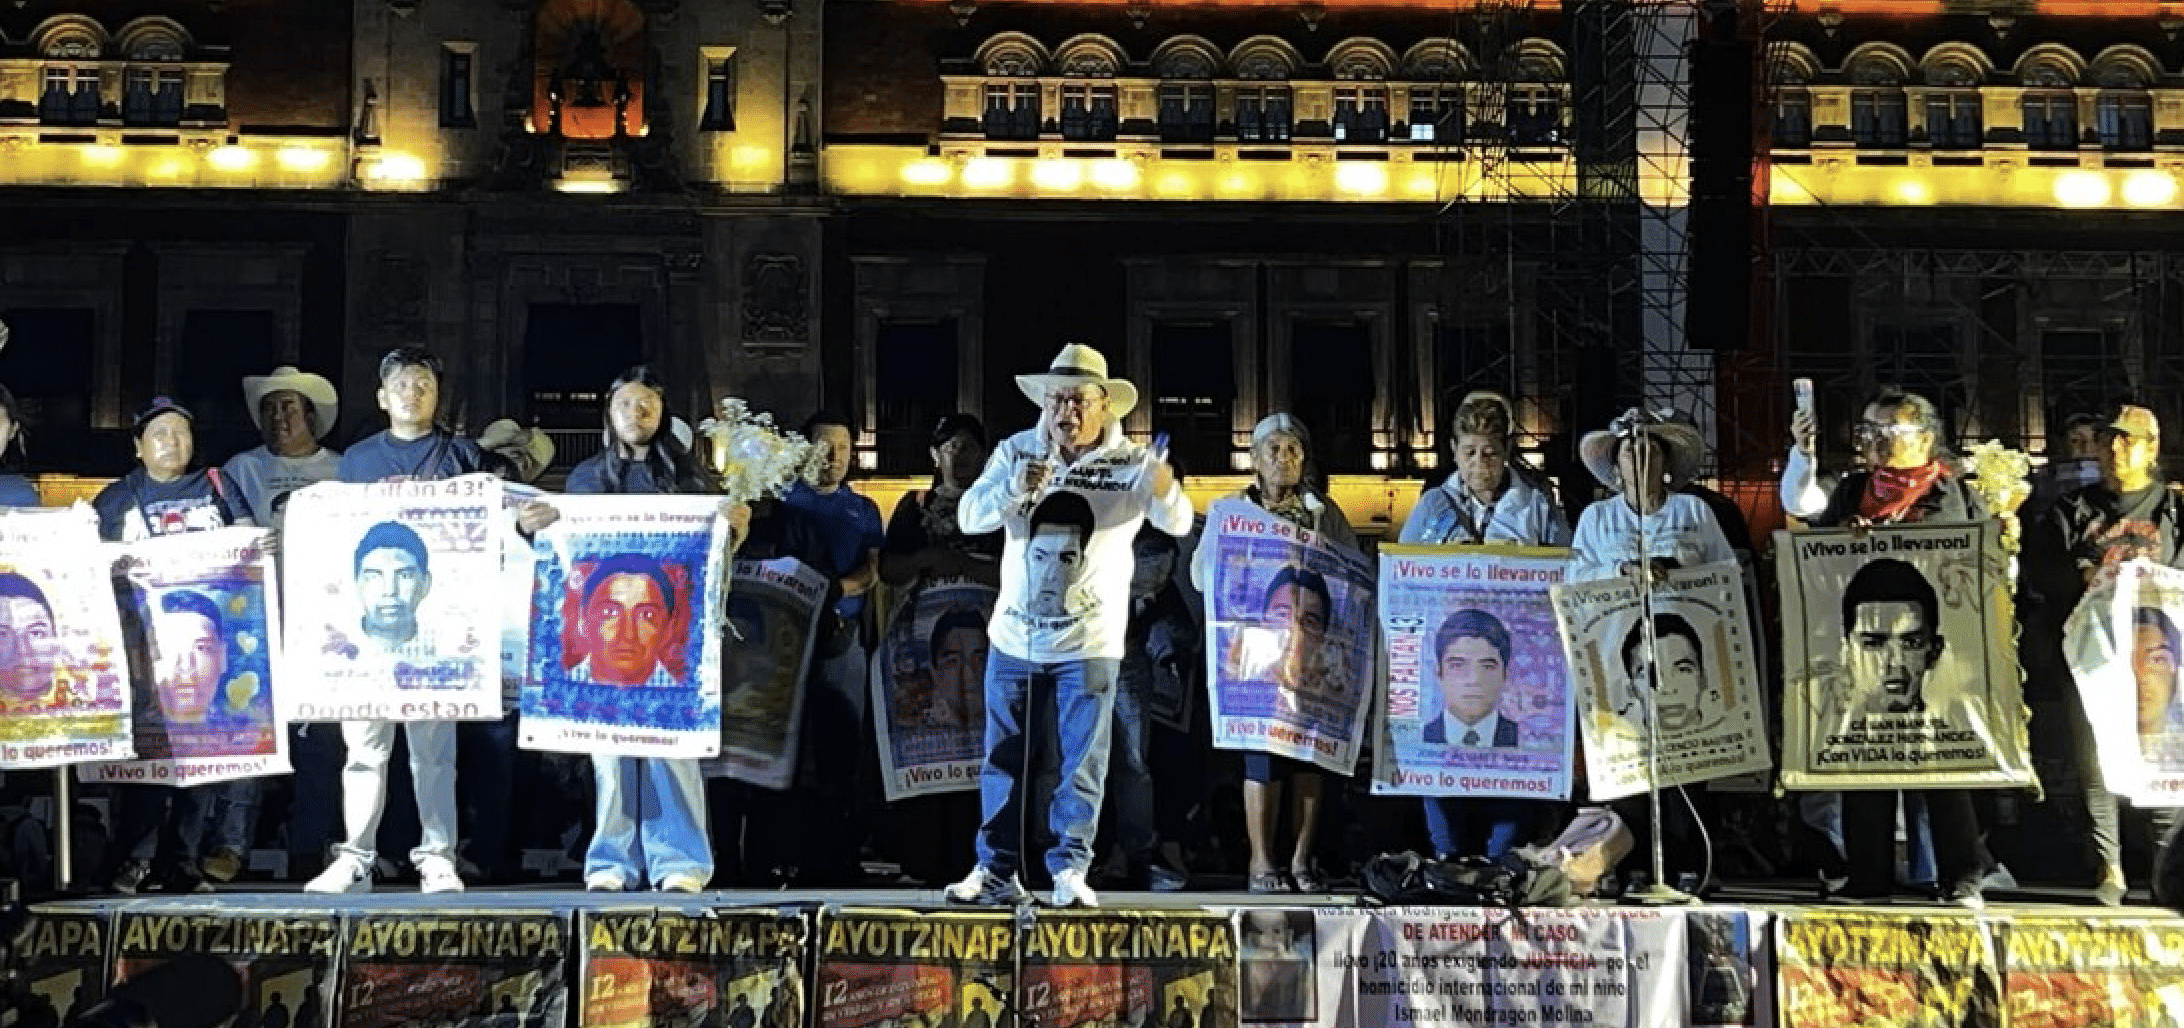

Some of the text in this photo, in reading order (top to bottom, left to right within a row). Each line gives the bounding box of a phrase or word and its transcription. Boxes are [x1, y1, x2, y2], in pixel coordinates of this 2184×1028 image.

[1222, 514, 1265, 534] ¡Vivo
[1271, 522, 1291, 536] se
[1802, 533, 1970, 561] ¡Vivo se lo llevaron!
[1393, 560, 1565, 584] ¡Vivo se lo llevaron!
[1, 740, 114, 760] lo queremos!
[1816, 746, 1987, 766] ¡Con VIDA lo queremos!
[99, 763, 145, 782] ¡Vivo
[151, 762, 169, 779] lo
[905, 766, 943, 789] ¡Vivo
[947, 764, 963, 780] lo
[1391, 769, 1553, 794] ¡Vivo lo queremos!
[122, 915, 335, 956] AYOTZINAPA
[348, 918, 561, 958] AYOTZINAPA
[823, 920, 1016, 961] AYOTZINAP
[1024, 922, 1234, 961] AYOTZINAPA
[1402, 922, 1424, 942] DE
[1429, 922, 1501, 942] ATENDER
[1533, 923, 1579, 942] CASO
[1522, 951, 1597, 970] JUSTICIA
[1605, 955, 1629, 976] po
[822, 978, 848, 1007] 12
[1025, 981, 1050, 1010] 12
[1359, 976, 1435, 996] homicidio
[1439, 976, 1541, 996] internacional
[1545, 978, 1565, 996] de
[1569, 978, 1589, 996] mi
[1395, 1004, 1447, 1022] Ismael
[1541, 1004, 1593, 1022] Molina
